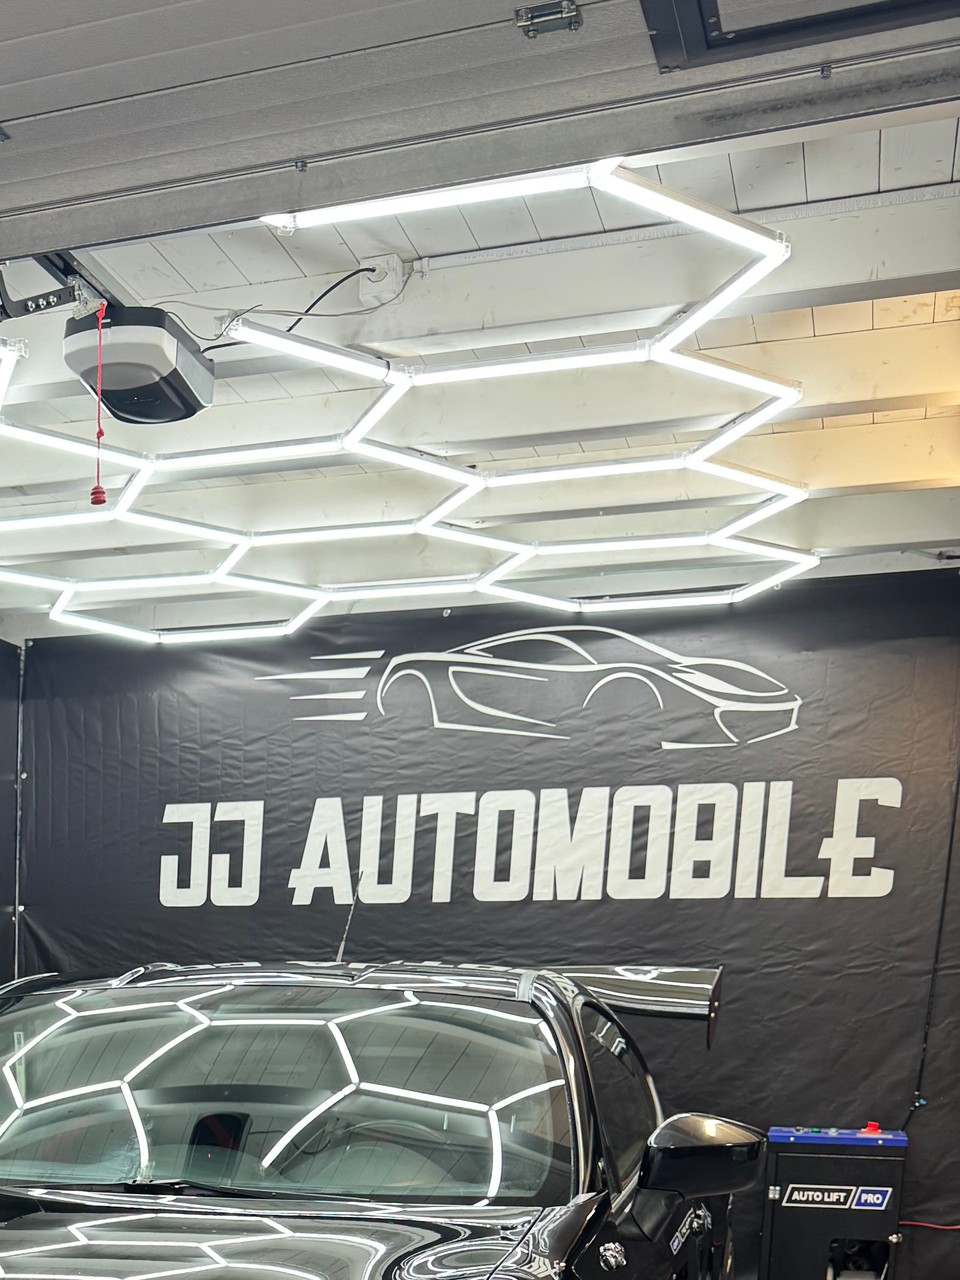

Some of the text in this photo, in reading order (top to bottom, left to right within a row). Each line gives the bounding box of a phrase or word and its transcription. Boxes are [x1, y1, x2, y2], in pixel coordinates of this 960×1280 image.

[159, 777, 902, 907] JJ AUTOMOBILE
[792, 1190, 883, 1204] AUTO LIFT PRO
